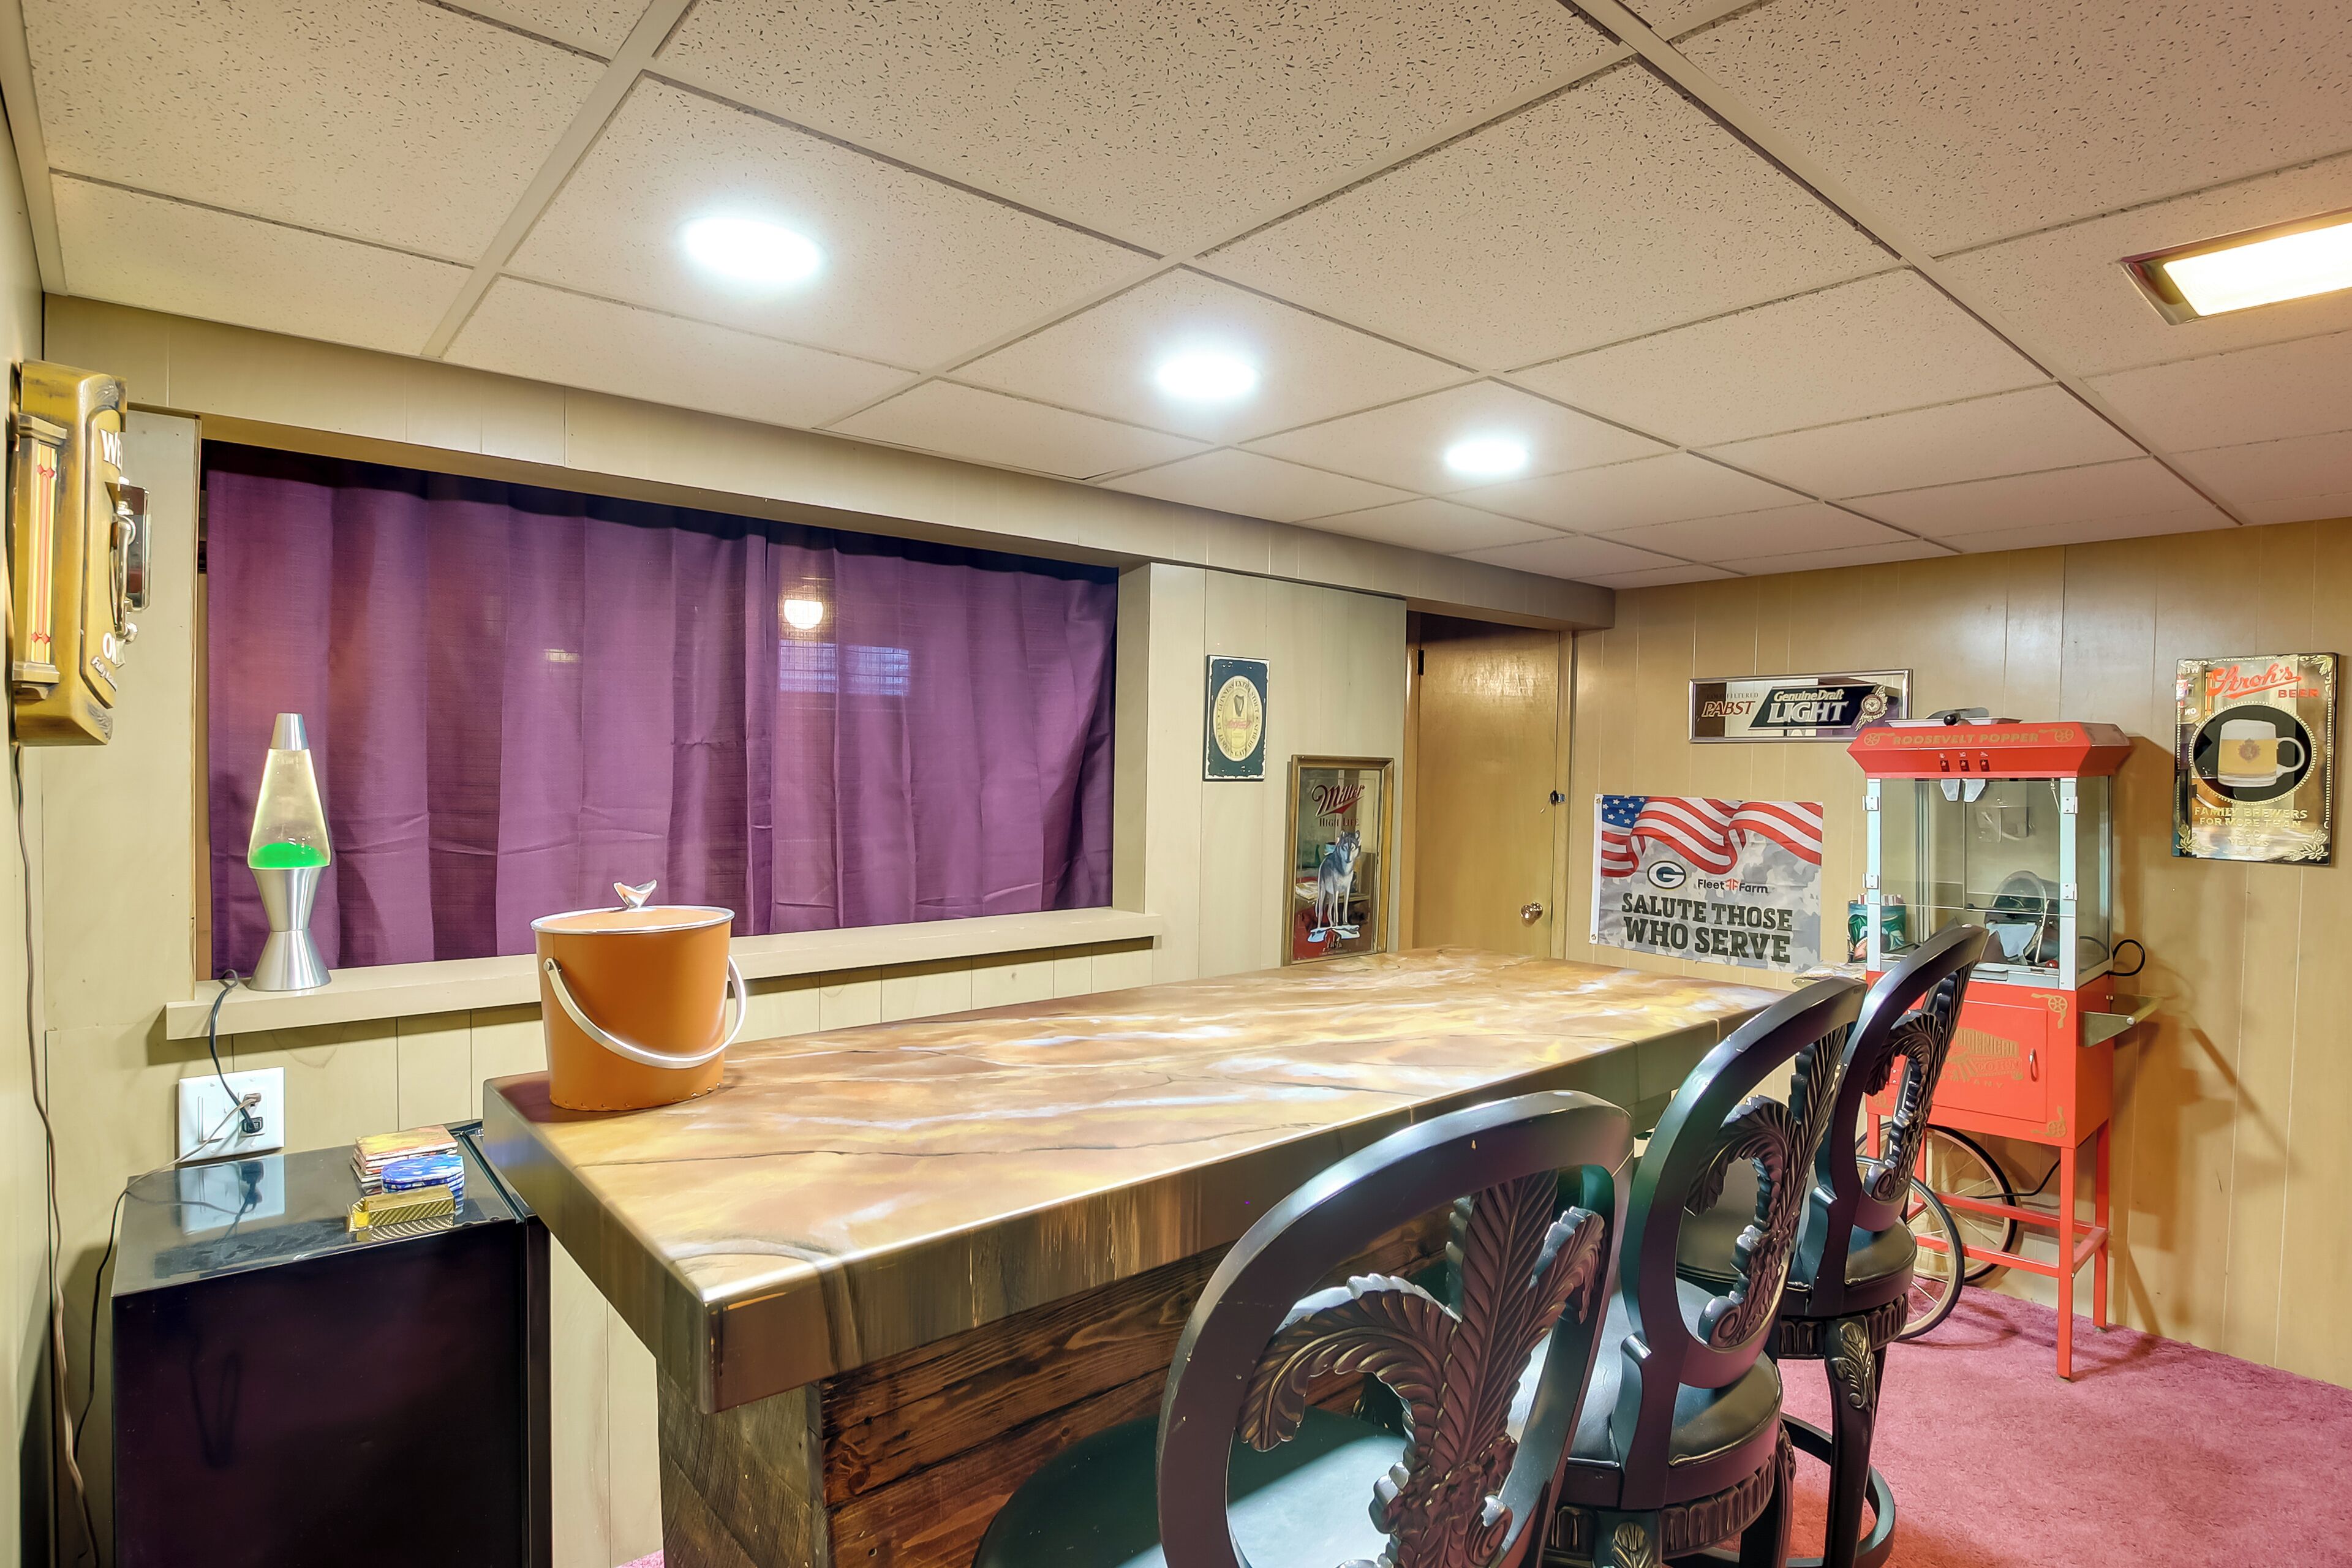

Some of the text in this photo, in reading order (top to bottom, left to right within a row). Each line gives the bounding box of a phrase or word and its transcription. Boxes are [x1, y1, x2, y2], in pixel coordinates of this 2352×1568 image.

[2205, 662, 2302, 699] Stroh's
[2278, 688, 2319, 698] BEER
[1702, 700, 1756, 718] PABST
[1767, 700, 1849, 723] LIGHT
[1893, 733, 2040, 745] ROOSEVELT POPPER
[1311, 784, 1366, 818] Miller
[2194, 807, 2308, 820] FAMILY BREWERS
[1319, 818, 1360, 827] HIGH LIFE
[2199, 817, 2302, 829] FOR MORE THAN
[2235, 829, 2263, 838] 200
[1697, 878, 1725, 890] Fleet
[1739, 883, 1769, 894] Farm
[1622, 892, 1793, 932] SALUTE THOSE
[1623, 916, 1791, 963] WHO SERVE
